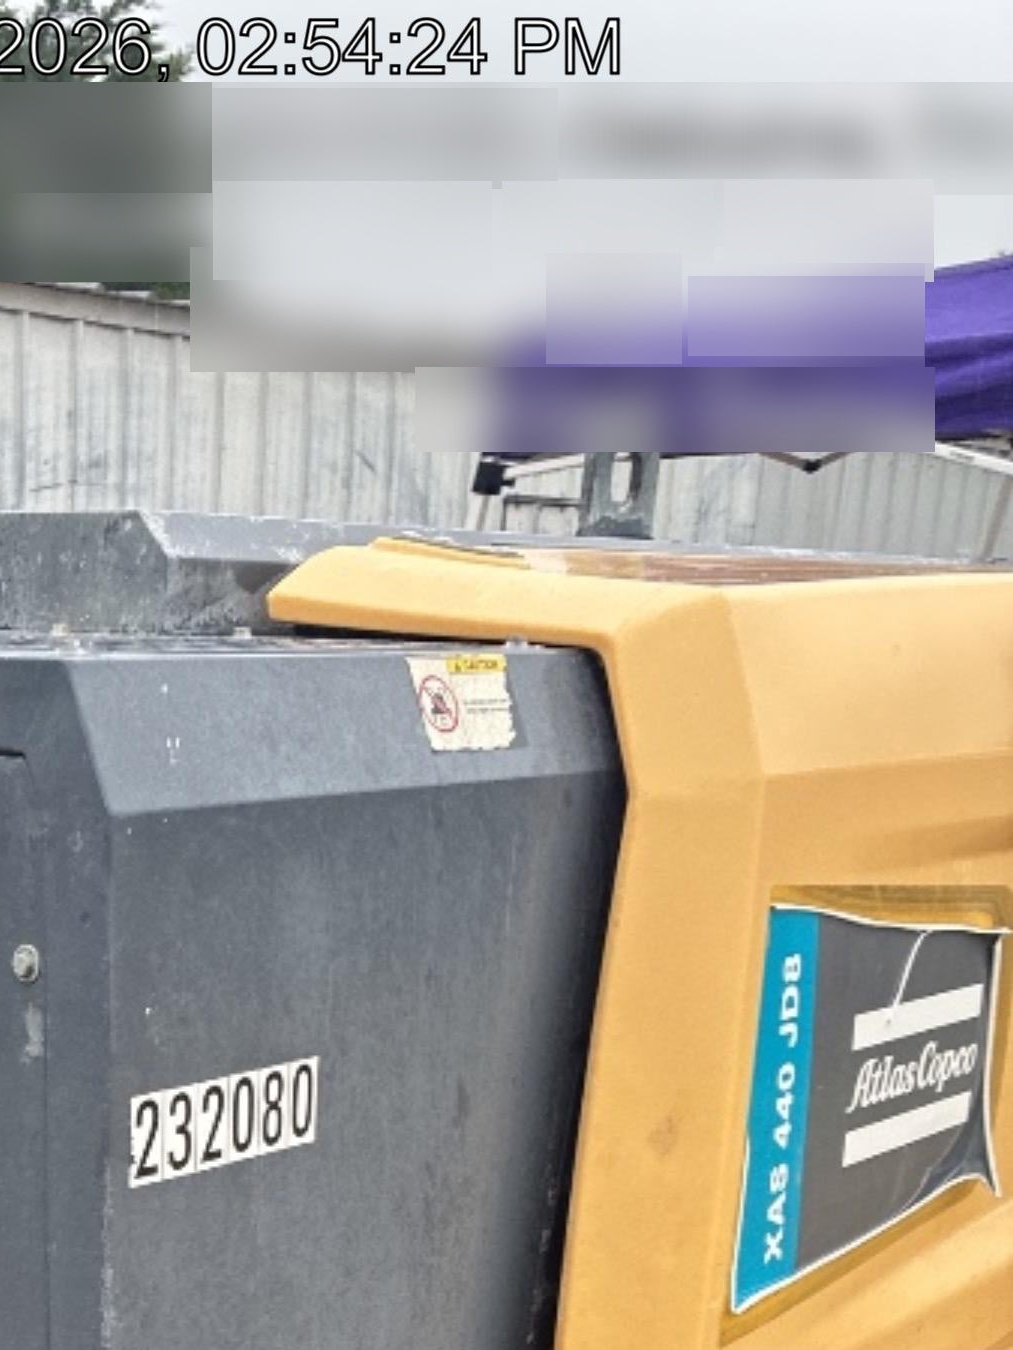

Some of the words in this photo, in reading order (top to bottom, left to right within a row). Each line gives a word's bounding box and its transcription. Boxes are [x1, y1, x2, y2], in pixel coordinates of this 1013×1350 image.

[135, 1064, 312, 1179] 232080
[772, 1062, 796, 1150] 440
[763, 1163, 789, 1265] XAS
